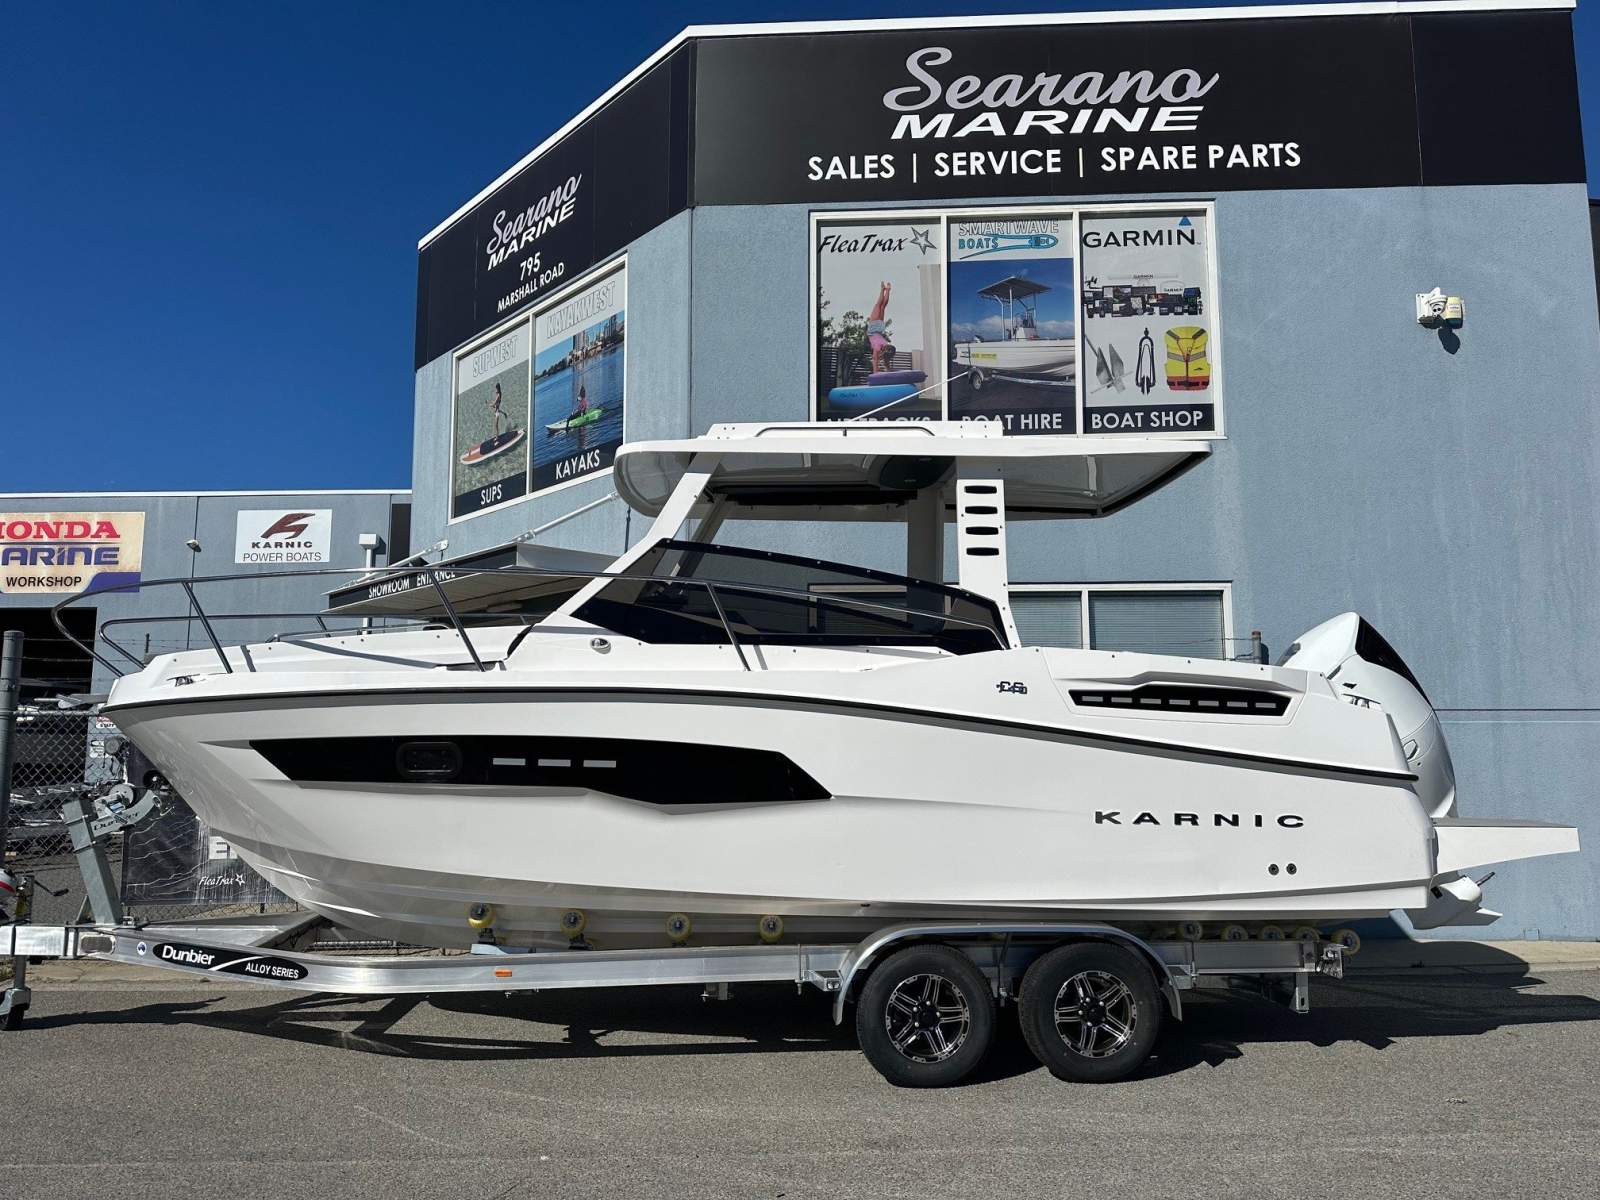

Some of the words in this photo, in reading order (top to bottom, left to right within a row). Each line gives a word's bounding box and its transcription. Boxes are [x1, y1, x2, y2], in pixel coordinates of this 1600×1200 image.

[883, 46, 1220, 111] Searano
[890, 106, 1204, 139] MARINE
[807, 153, 896, 181] SALES
[934, 149, 1062, 177] SERVICE
[1100, 145, 1197, 172] SPARE
[1208, 142, 1301, 169] PARTS
[486, 173, 582, 255] Searano
[487, 197, 577, 271] MARINE
[958, 219, 1060, 236] SMARTWAVE
[818, 233, 909, 254] FleaTrax
[958, 237, 999, 250] BOATS
[1082, 229, 1196, 248] GARMIN
[520, 251, 541, 281] 795
[497, 278, 538, 313] MARSHALL
[539, 262, 565, 288] ROAD
[546, 281, 616, 340] KAYAKWEST
[472, 334, 518, 378] SUPWEST
[1020, 413, 1063, 430] HIRE
[1091, 412, 1144, 429] BOAT
[1150, 410, 1203, 428] SHOP
[555, 449, 601, 480] KAYAKS
[480, 484, 502, 506] SUPS
[0, 521, 121, 540] ONDA
[251, 541, 313, 549] KARNIC
[243, 552, 283, 562] POWER
[286, 552, 322, 562] BOATS
[6, 576, 82, 588] WORKSHOP
[368, 577, 410, 598] SHOWROOM
[1095, 811, 1304, 828] KARNIC
[199, 875, 234, 887] FleaTrax
[162, 945, 215, 965] Dunbier
[244, 962, 271, 975] ALLOY
[271, 967, 300, 979] SERIES
